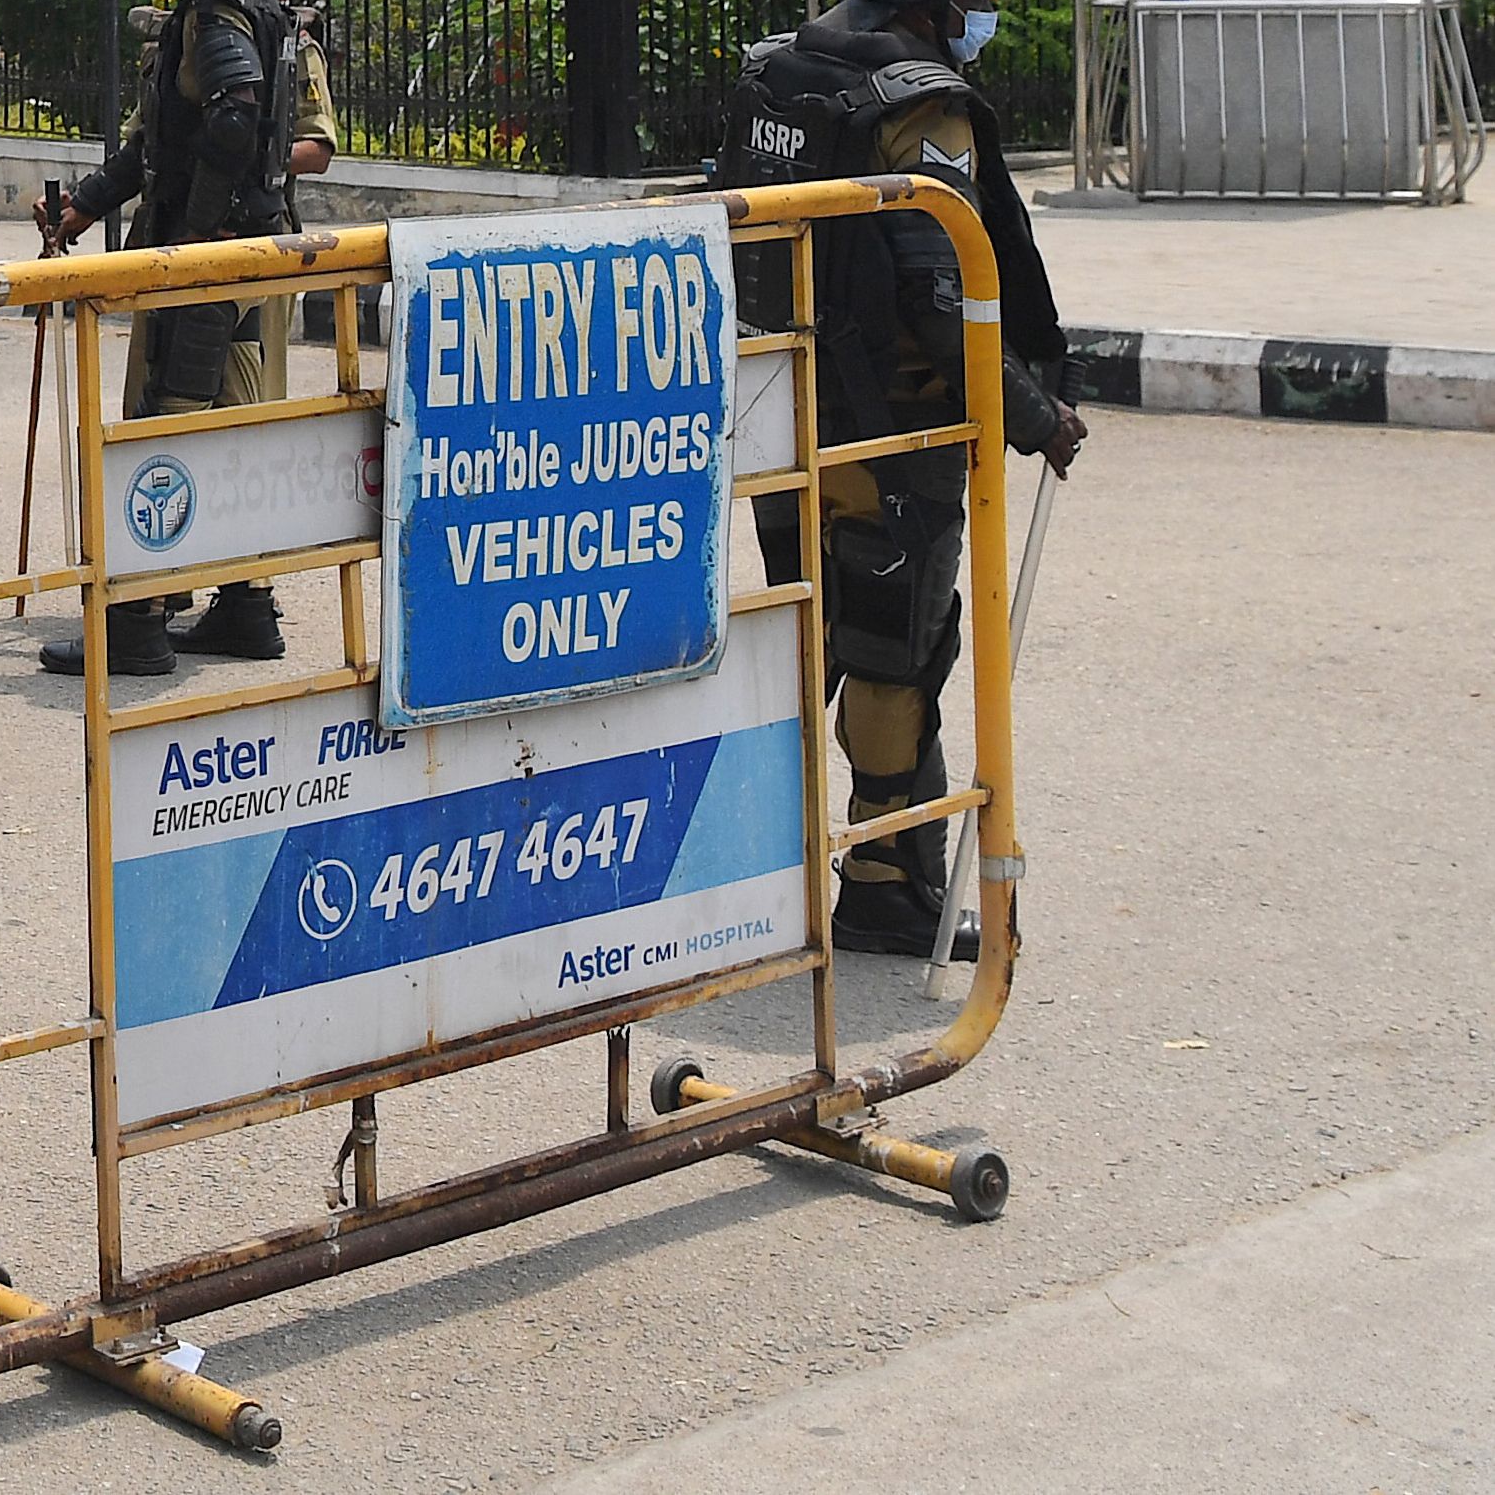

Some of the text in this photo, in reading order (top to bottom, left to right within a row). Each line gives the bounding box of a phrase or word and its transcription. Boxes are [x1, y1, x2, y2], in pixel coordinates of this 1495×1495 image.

[751, 116, 805, 159] KSRP
[425, 252, 712, 409] ENTRY FOR
[571, 411, 711, 485] JUDGES
[446, 500, 685, 587] VEHICLES
[502, 589, 630, 663] ONLY
[159, 736, 275, 795] Aster
[152, 771, 352, 837] EMERGENCY CARE
[370, 798, 650, 921] 4647 4647
[558, 917, 774, 989] Aster CMI HOSPITAL
